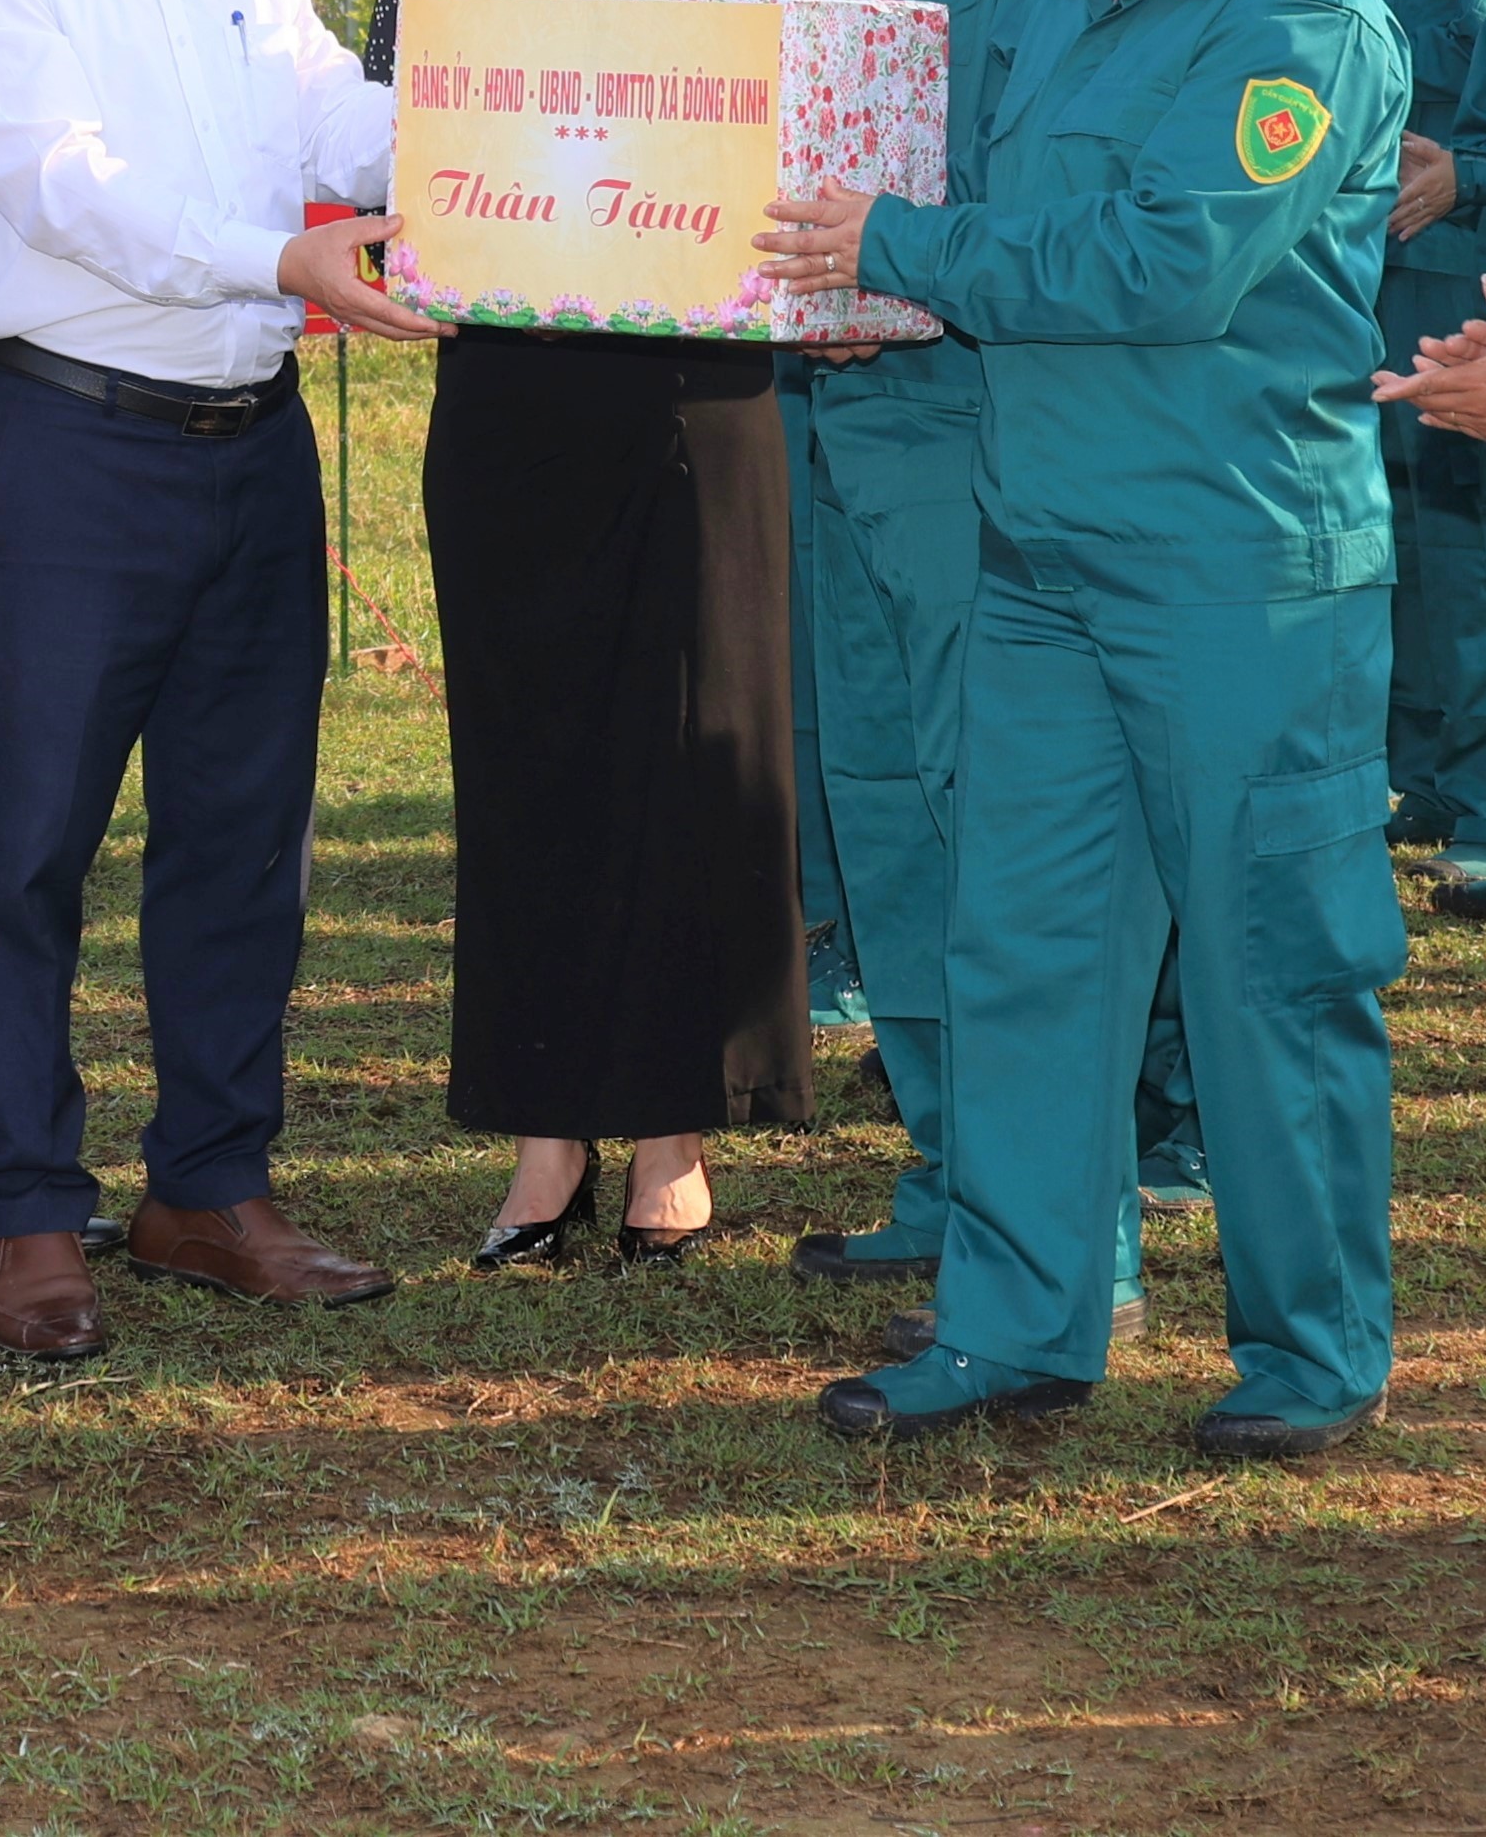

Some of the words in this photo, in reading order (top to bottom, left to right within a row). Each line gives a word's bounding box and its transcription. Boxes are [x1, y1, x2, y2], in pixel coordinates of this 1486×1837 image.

[411, 50, 449, 110] ĐẢNG
[452, 51, 472, 110] ỦY
[484, 68, 525, 113] HĐND
[540, 70, 582, 116] UBND
[595, 72, 656, 124] UBMTTQ
[659, 66, 679, 122] XÃ
[682, 67, 725, 123] ĐÔNG
[728, 77, 769, 125] KINH
[428, 169, 559, 223] Thân
[587, 178, 724, 245] Tặng
